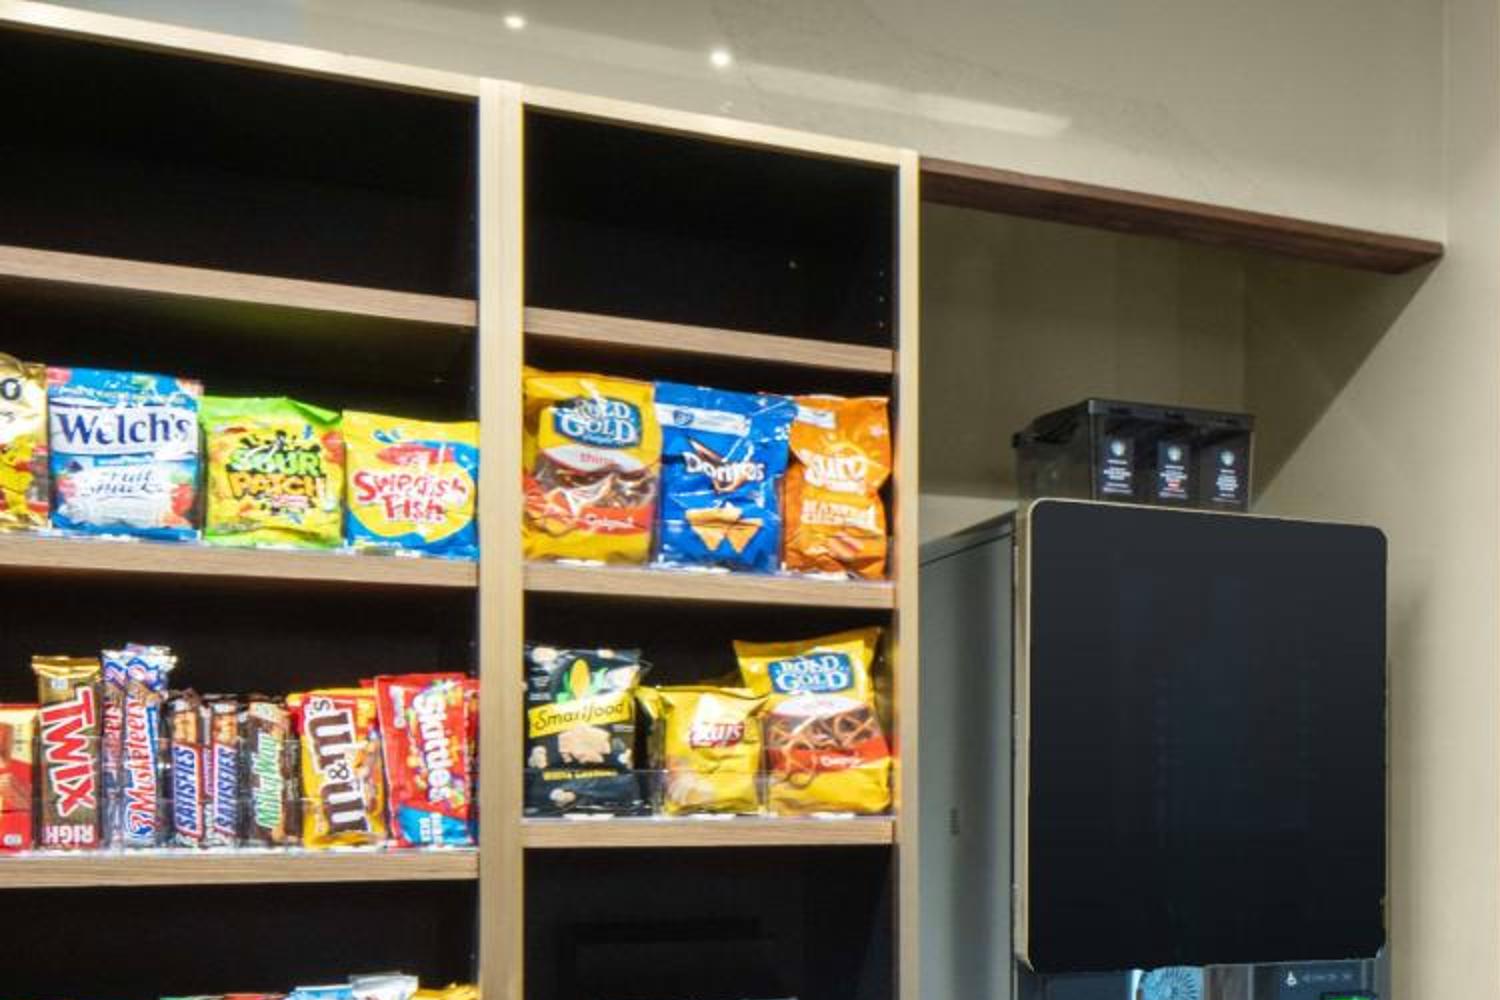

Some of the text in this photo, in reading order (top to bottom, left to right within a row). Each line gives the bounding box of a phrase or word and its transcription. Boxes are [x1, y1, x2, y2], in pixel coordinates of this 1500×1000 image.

[55, 412, 190, 446] Welch's
[560, 414, 638, 443] GOLD
[682, 451, 766, 484] Doritos
[779, 655, 840, 674] ROLD
[775, 670, 850, 693] GOLD
[532, 702, 625, 732] Smartfood
[40, 686, 95, 816] TWIX
[126, 697, 158, 813] Musketeers
[412, 684, 456, 803] Skittles
[173, 746, 198, 832] SATISFIES
[215, 746, 237, 832] SATISFIES
[41, 824, 95, 844] RIGH
